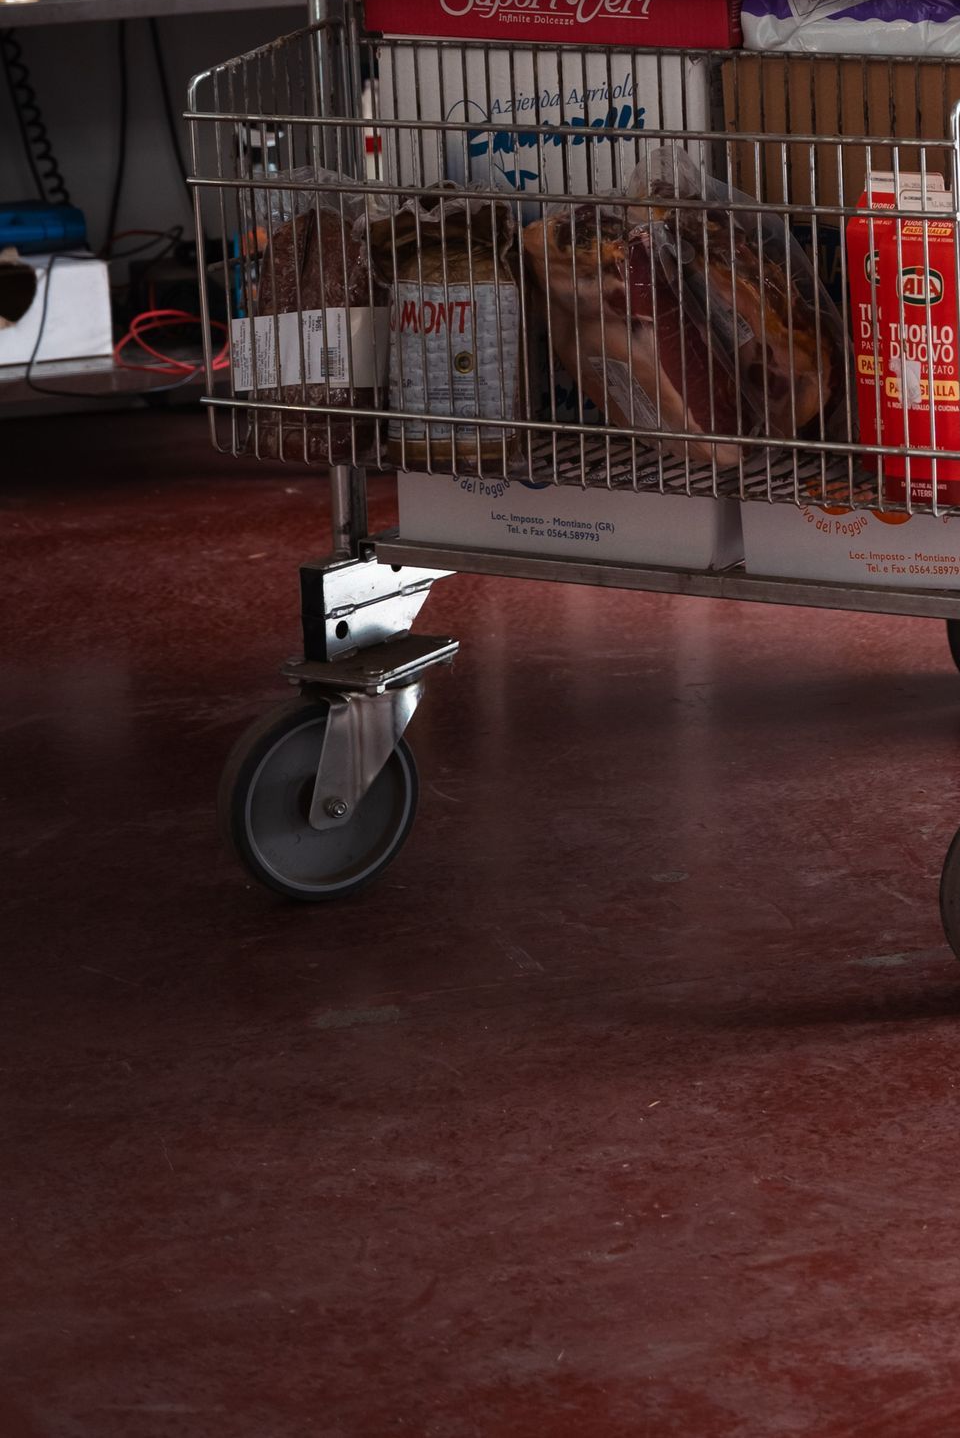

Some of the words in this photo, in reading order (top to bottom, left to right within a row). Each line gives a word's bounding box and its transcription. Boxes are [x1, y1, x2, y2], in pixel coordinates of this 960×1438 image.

[498, 13, 531, 24] Infinite
[534, 14, 575, 26] Dolcezze
[491, 89, 560, 115] Azienda
[566, 73, 639, 111] Agricola
[460, 479, 476, 494] del
[479, 478, 512, 499] Poggio
[491, 511, 509, 521] Loc.
[510, 513, 545, 525] Imposto
[553, 517, 593, 530] Montiano
[594, 522, 615, 534] (GR)
[815, 518, 832, 534] del
[835, 516, 868, 537] Poggio
[506, 524, 521, 534] Tel.
[530, 527, 545, 537] Fax
[546, 529, 601, 543] 0564.589793
[849, 550, 867, 561] Loc.
[869, 551, 905, 563] Imposto
[914, 553, 956, 563] Montiano
[865, 563, 881, 573] Tel.
[891, 564, 906, 574] Fax
